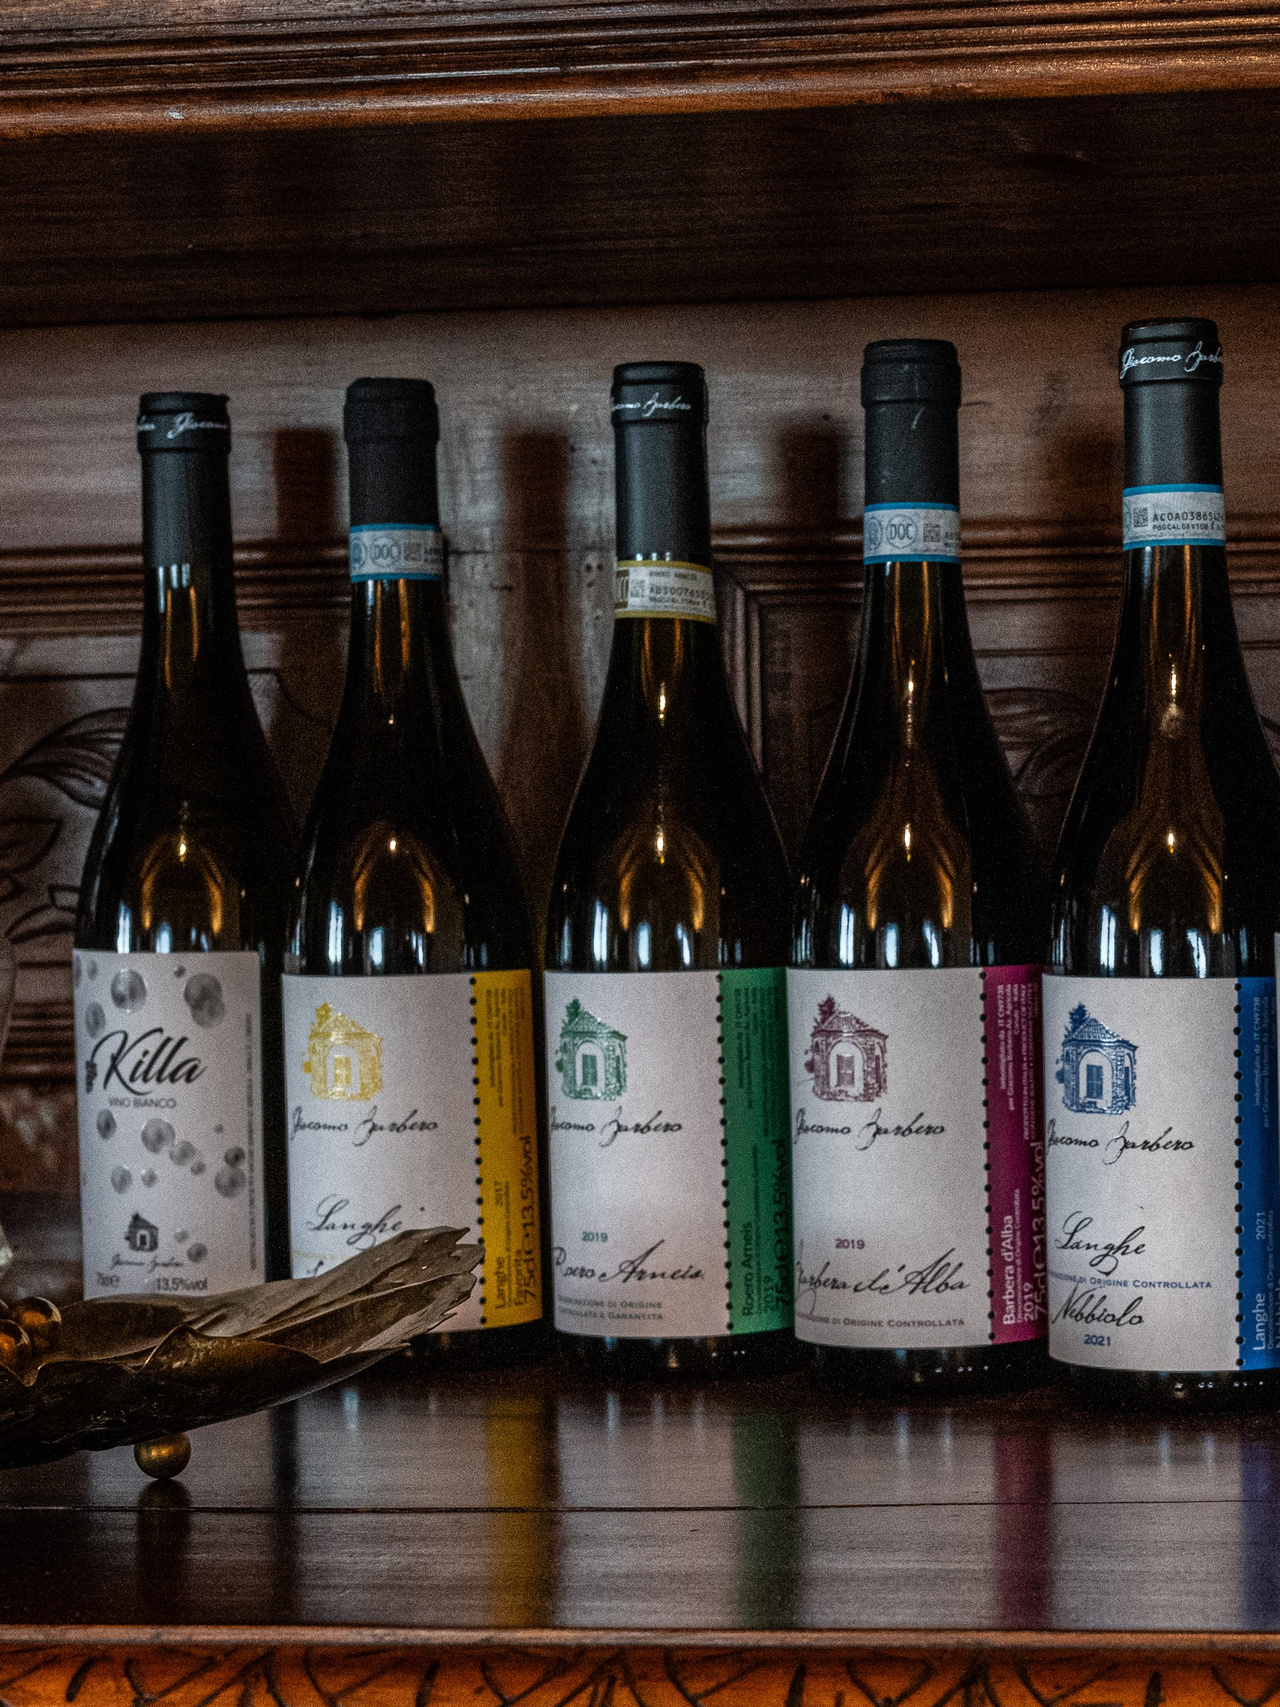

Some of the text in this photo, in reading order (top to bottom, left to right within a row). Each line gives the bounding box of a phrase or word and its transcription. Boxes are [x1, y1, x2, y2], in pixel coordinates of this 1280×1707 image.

[890, 524, 913, 540] DOC
[91, 1026, 208, 1097] Killa
[133, 1098, 177, 1109] BIANCO
[352, 1105, 439, 1147] Barbero
[599, 1105, 684, 1148] Barbero
[856, 1108, 947, 1151] Barbero
[1101, 1120, 1195, 1166] Barbero
[305, 1193, 404, 1251] Langhe
[581, 1230, 609, 1243] 2019
[834, 1237, 865, 1251] 2019
[1054, 1210, 1147, 1277] Langhe
[1001, 1214, 1016, 1326] Barbera d'Alba
[1089, 1277, 1129, 1288] ORIGINE
[1132, 1279, 1213, 1290] CONTROLLATA
[1251, 1211, 1269, 1351] Langhe 2021
[1023, 1282, 1035, 1322] 2019
[1052, 1282, 1145, 1328] Nebbiolo
[886, 1318, 965, 1329] CONTROLLATA
[1083, 1334, 1112, 1347] 2021
